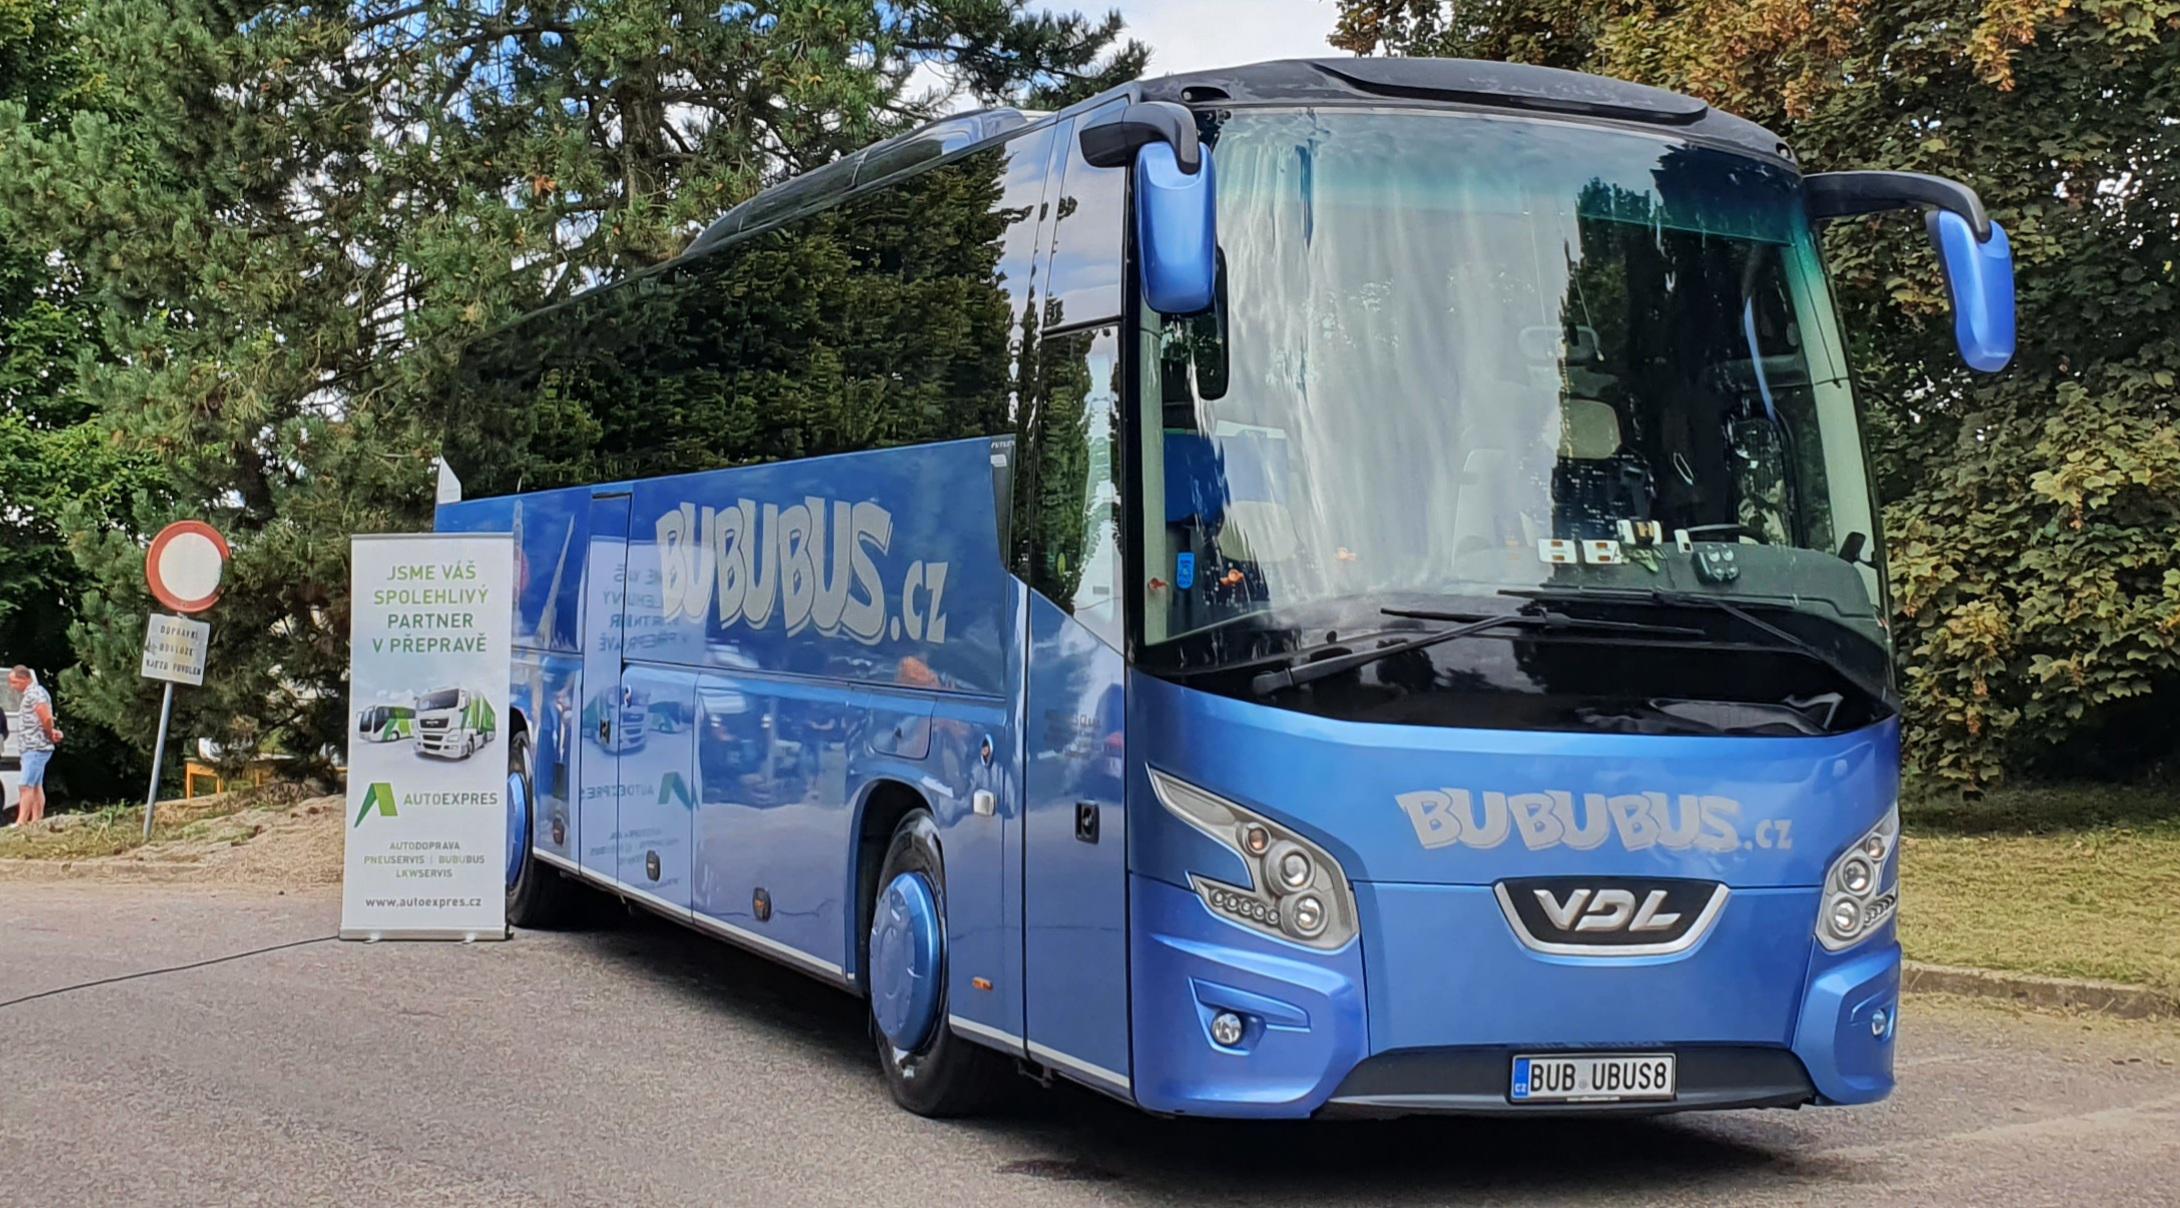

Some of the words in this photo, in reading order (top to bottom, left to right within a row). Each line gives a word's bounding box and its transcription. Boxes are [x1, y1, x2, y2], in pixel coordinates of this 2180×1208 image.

[386, 565, 435, 581] JSME
[442, 560, 476, 580] VÁŠ
[373, 584, 489, 605] SPOLEHLIVÝ
[387, 613, 473, 629] PARTNER
[372, 638, 383, 653] V
[390, 632, 487, 653] PŘEPRAVĚ
[403, 793, 498, 806] AUTOEXPRES
[389, 841, 460, 850] AUTODOPRAVA
[364, 855, 425, 865] PNEUSERVIS
[438, 855, 485, 864] BUBUBUS
[396, 869, 453, 878] LKWSERVIS
[365, 897, 482, 909] www.autoexpres.cz
[1533, 889, 1681, 932] VDL
[1531, 1064, 1576, 1091] BUB
[1592, 1062, 1667, 1090] UBUS8
